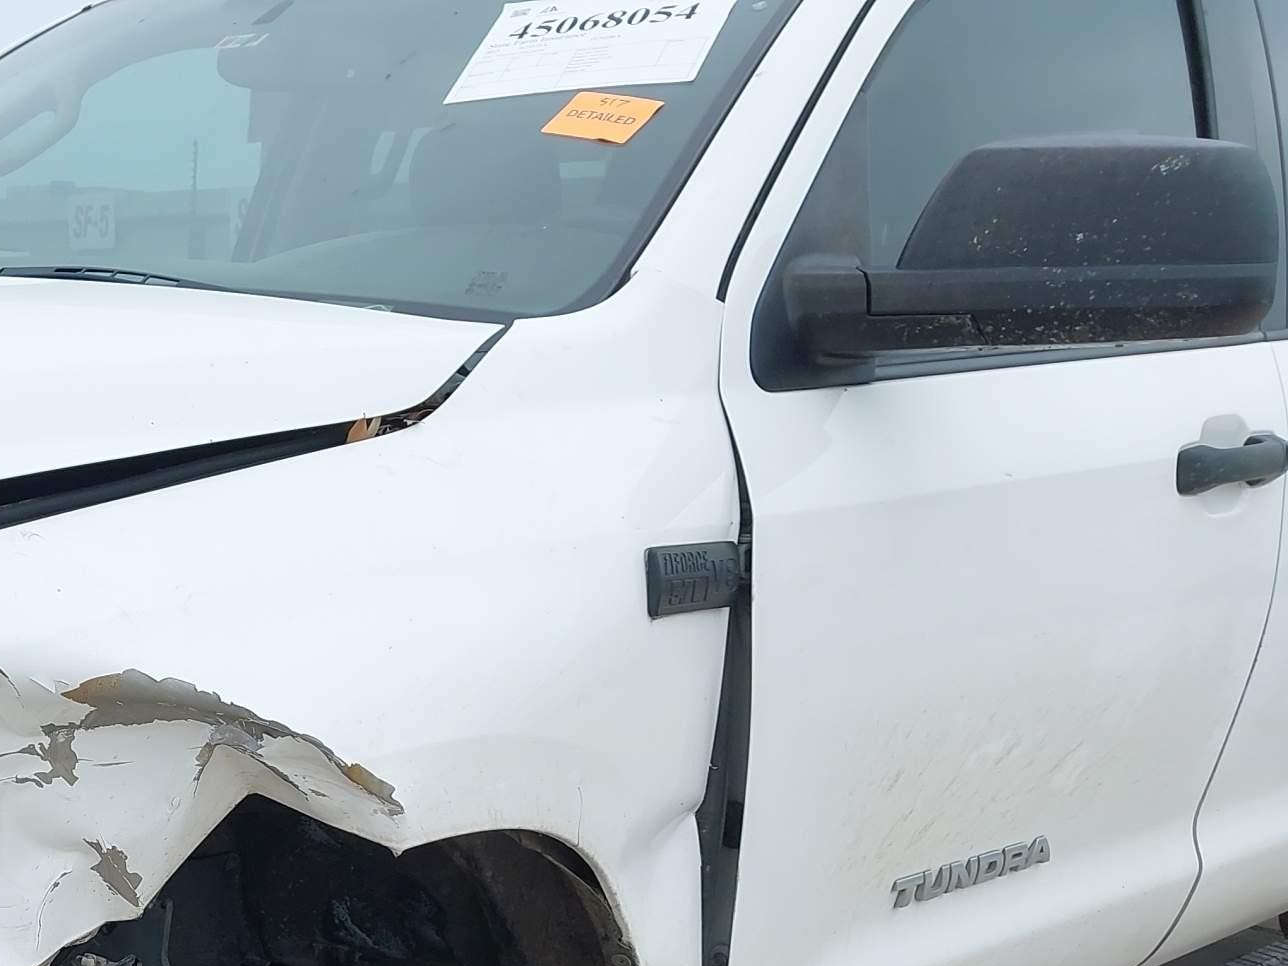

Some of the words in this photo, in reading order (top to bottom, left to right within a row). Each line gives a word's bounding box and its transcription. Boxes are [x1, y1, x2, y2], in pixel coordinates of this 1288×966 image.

[509, 2, 700, 40] 45068054
[566, 109, 636, 125] DETAILED
[72, 204, 110, 240] SF-5
[890, 834, 1052, 910] TUNDRA
